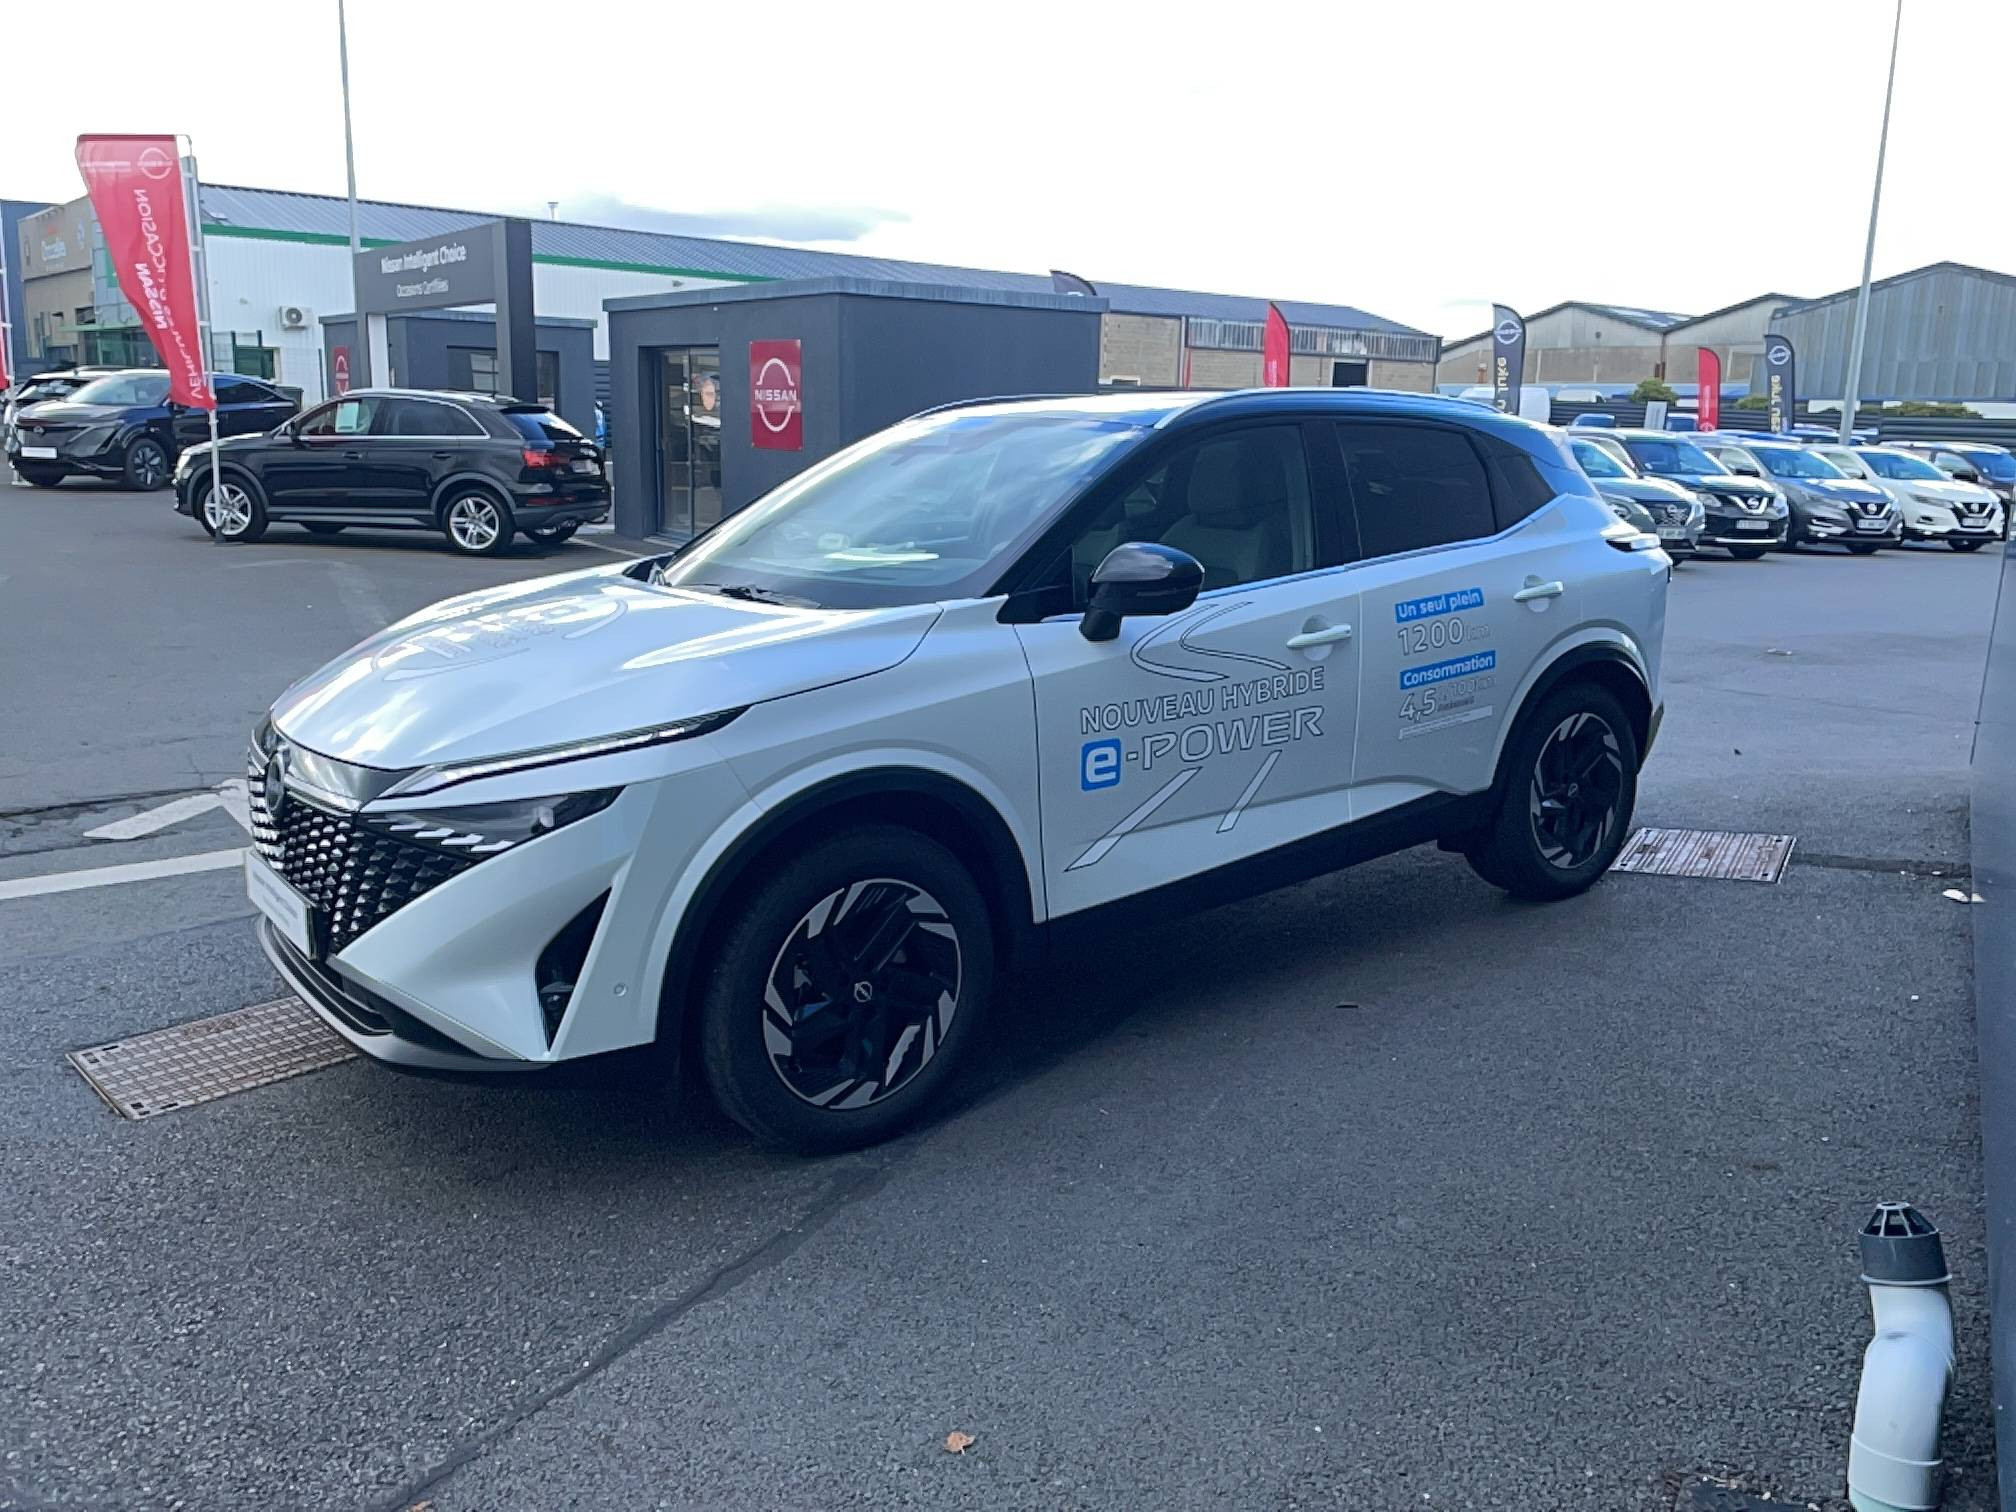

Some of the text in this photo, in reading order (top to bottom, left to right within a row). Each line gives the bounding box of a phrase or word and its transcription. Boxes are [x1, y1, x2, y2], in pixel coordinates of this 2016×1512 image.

[754, 389, 798, 402] NISSAN
[1397, 590, 1481, 618] Un seul plein
[1398, 617, 1464, 656] 1200
[1403, 655, 1493, 686] Consommation
[1081, 665, 1325, 735] NOUVEAU HYBRIDE
[1399, 687, 1437, 723] 4,5
[1084, 705, 1325, 784] e-POWER
